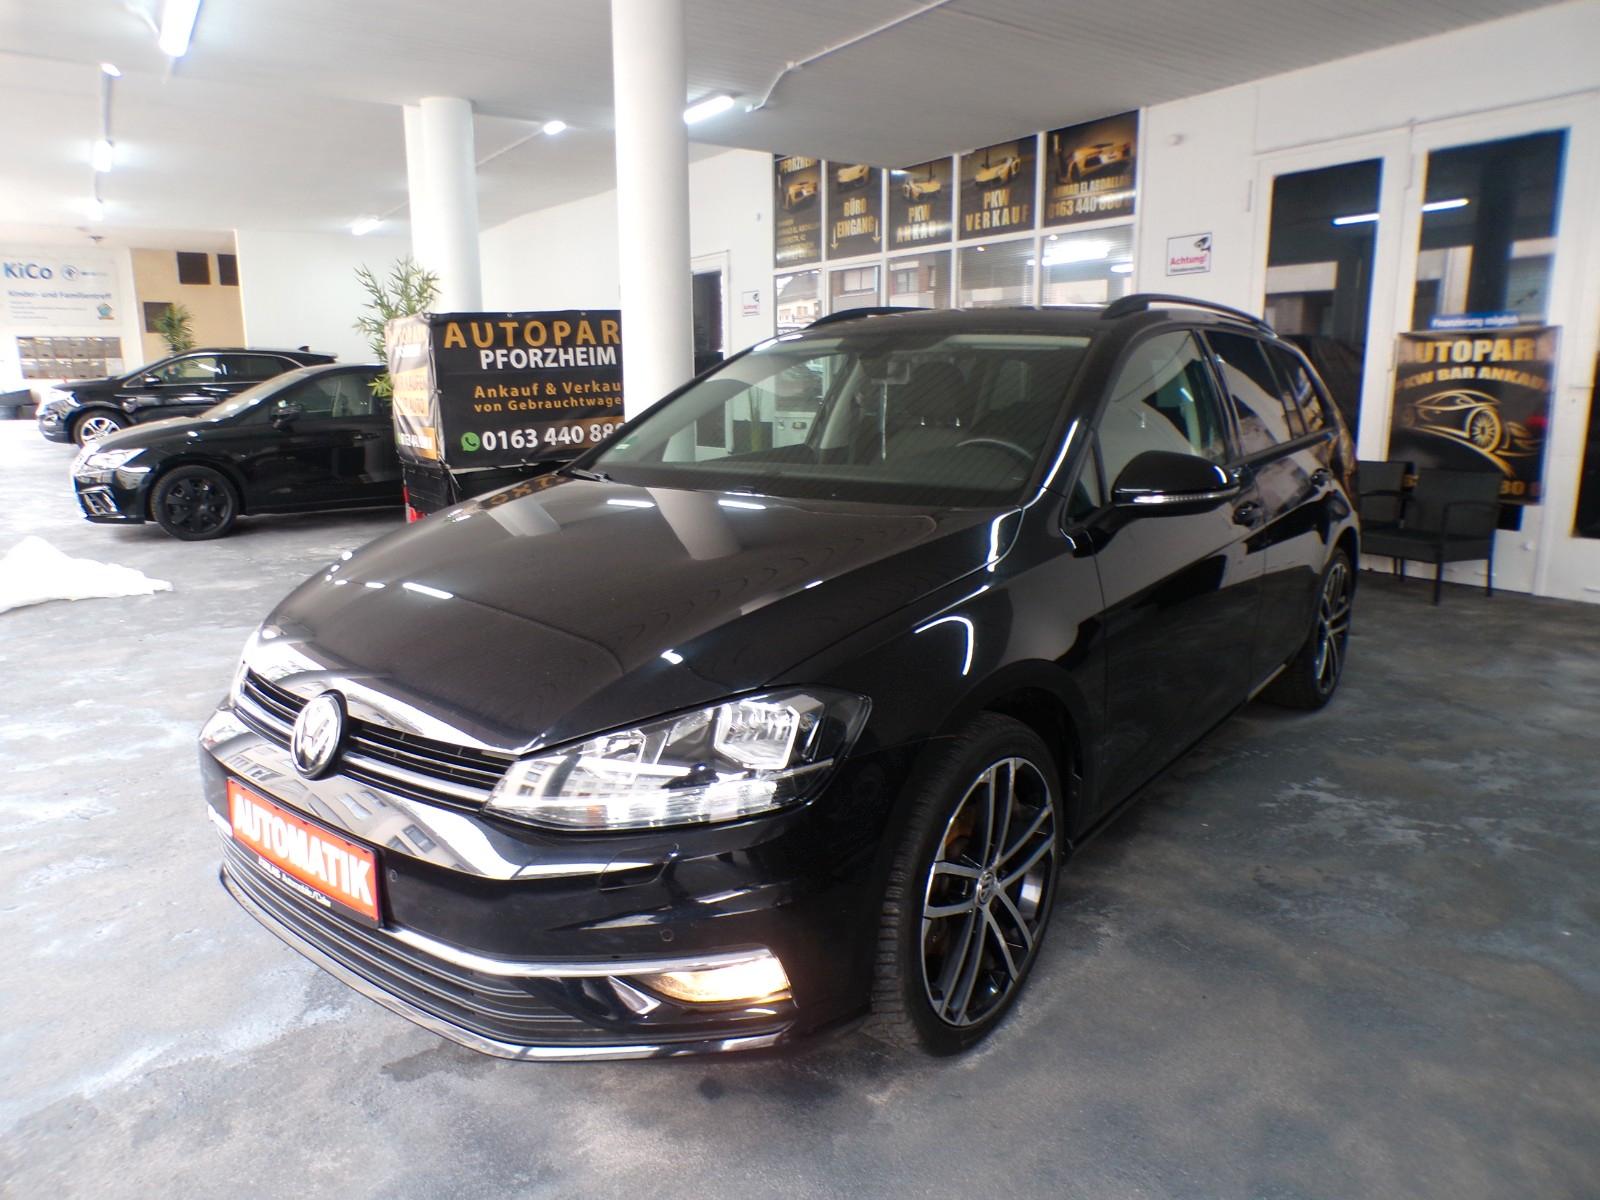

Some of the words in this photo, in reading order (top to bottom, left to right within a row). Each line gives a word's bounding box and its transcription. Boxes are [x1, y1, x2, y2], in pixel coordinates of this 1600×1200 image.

[844, 198, 867, 217] BÜRO
[984, 188, 1009, 210] PKW
[1075, 196, 1097, 214] 440
[908, 203, 931, 224] PKW
[966, 204, 1029, 231] VERKAUF
[836, 215, 875, 239] EINGANG
[896, 221, 944, 243] ANKAU
[1170, 254, 1208, 266] Achtung!
[4, 262, 53, 280] KiCo
[480, 346, 617, 370] PFORZHEIM
[1405, 338, 1548, 363] UTOPAR
[1437, 366, 1475, 381] BAR
[474, 382, 539, 398] Ankauf
[545, 382, 557, 396] &
[474, 402, 502, 413] von
[482, 429, 538, 451] 0163
[544, 425, 585, 446] 440
[233, 793, 374, 907] AUTOMATIK
